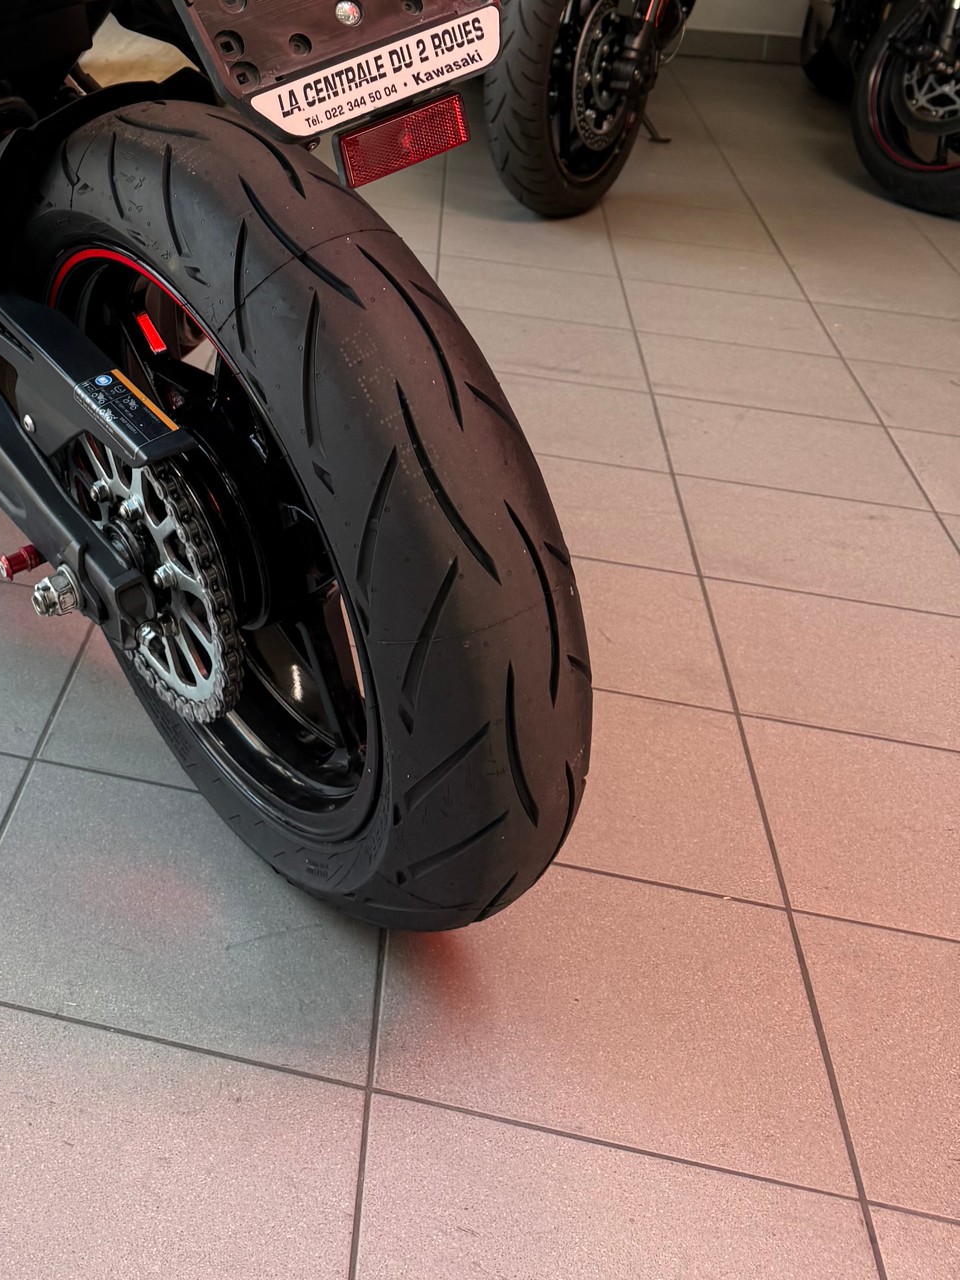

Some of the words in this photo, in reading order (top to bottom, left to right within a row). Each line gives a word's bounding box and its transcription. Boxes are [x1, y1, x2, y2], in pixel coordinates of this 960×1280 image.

[303, 54, 387, 107] CENTRALE
[388, 43, 414, 75] DU
[415, 38, 430, 64] 2
[430, 16, 485, 58] ROUES
[305, 115, 323, 129] Tél.
[324, 104, 345, 122] 022
[346, 94, 367, 113] 344
[368, 90, 383, 104] 50
[384, 84, 399, 98] 04
[411, 49, 484, 87] Kawasaki
